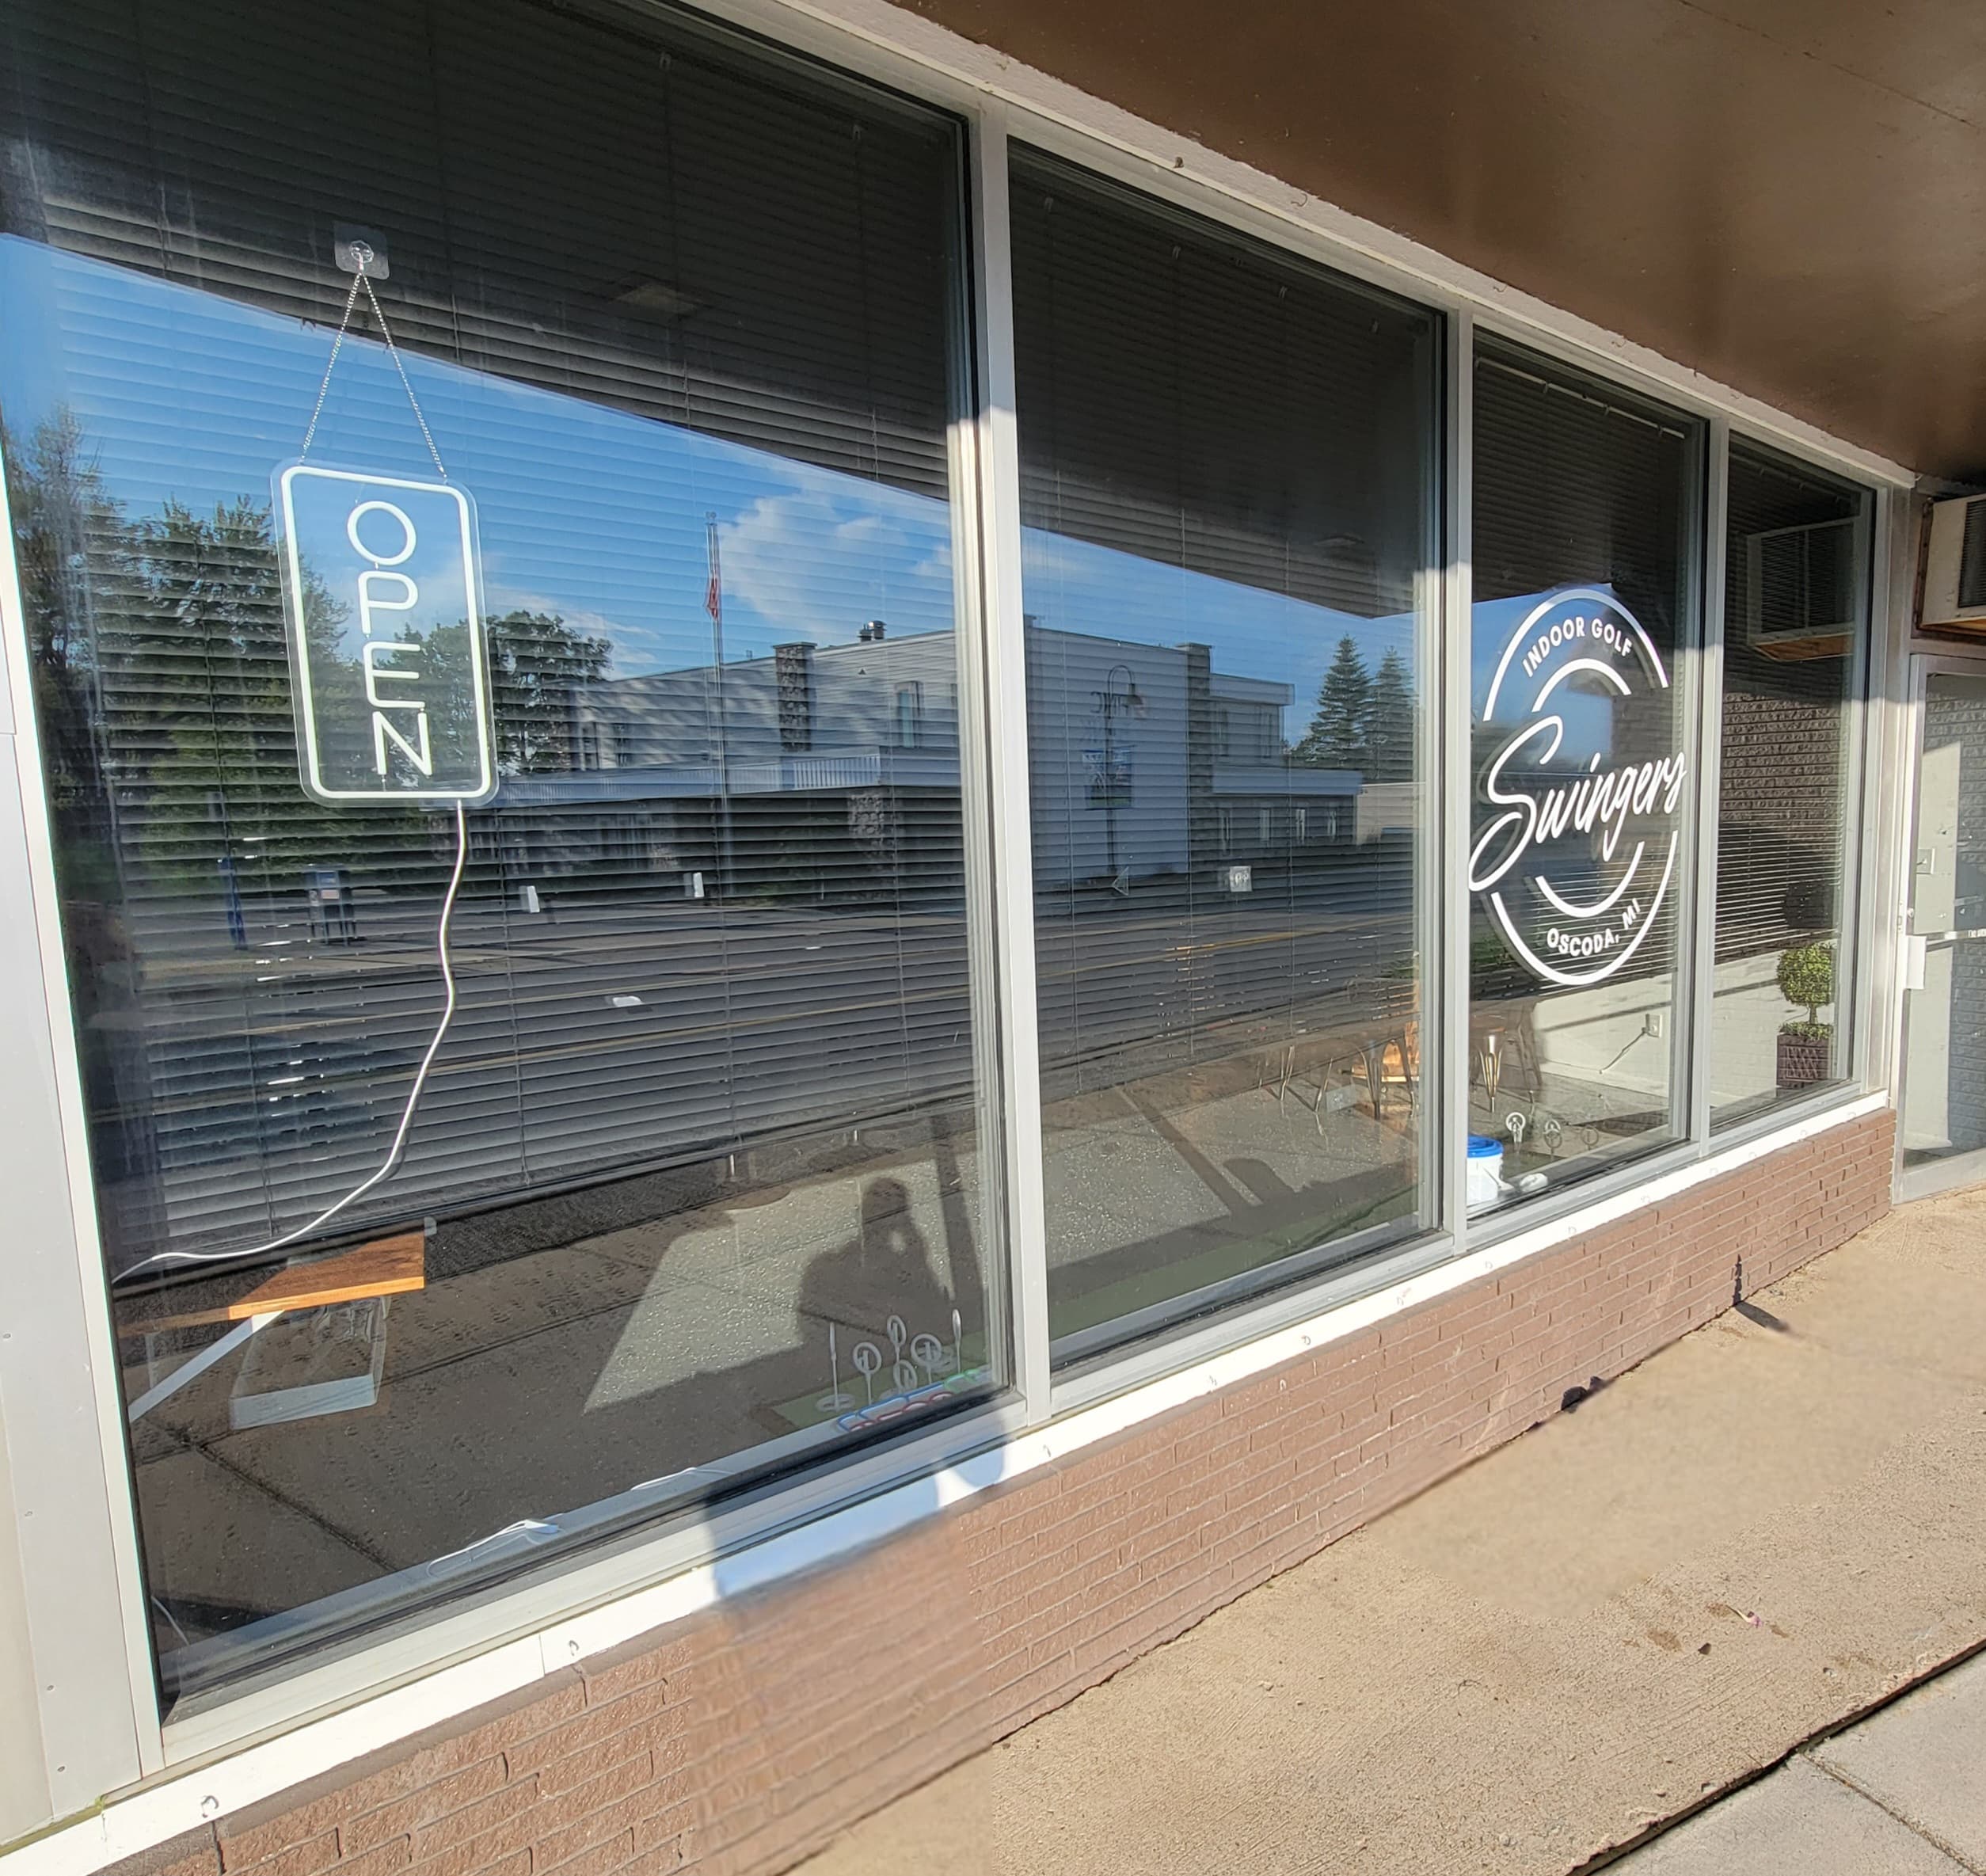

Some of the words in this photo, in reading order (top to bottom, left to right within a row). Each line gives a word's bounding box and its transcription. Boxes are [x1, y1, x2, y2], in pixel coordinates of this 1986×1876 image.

[347, 500, 433, 776] OPEN
[1522, 616, 1585, 678] INDOOR
[1591, 618, 1632, 656] GOLF
[1468, 715, 1687, 892] Swingers
[1547, 927, 1619, 957] OSCODA,
[1622, 897, 1641, 930] MI
